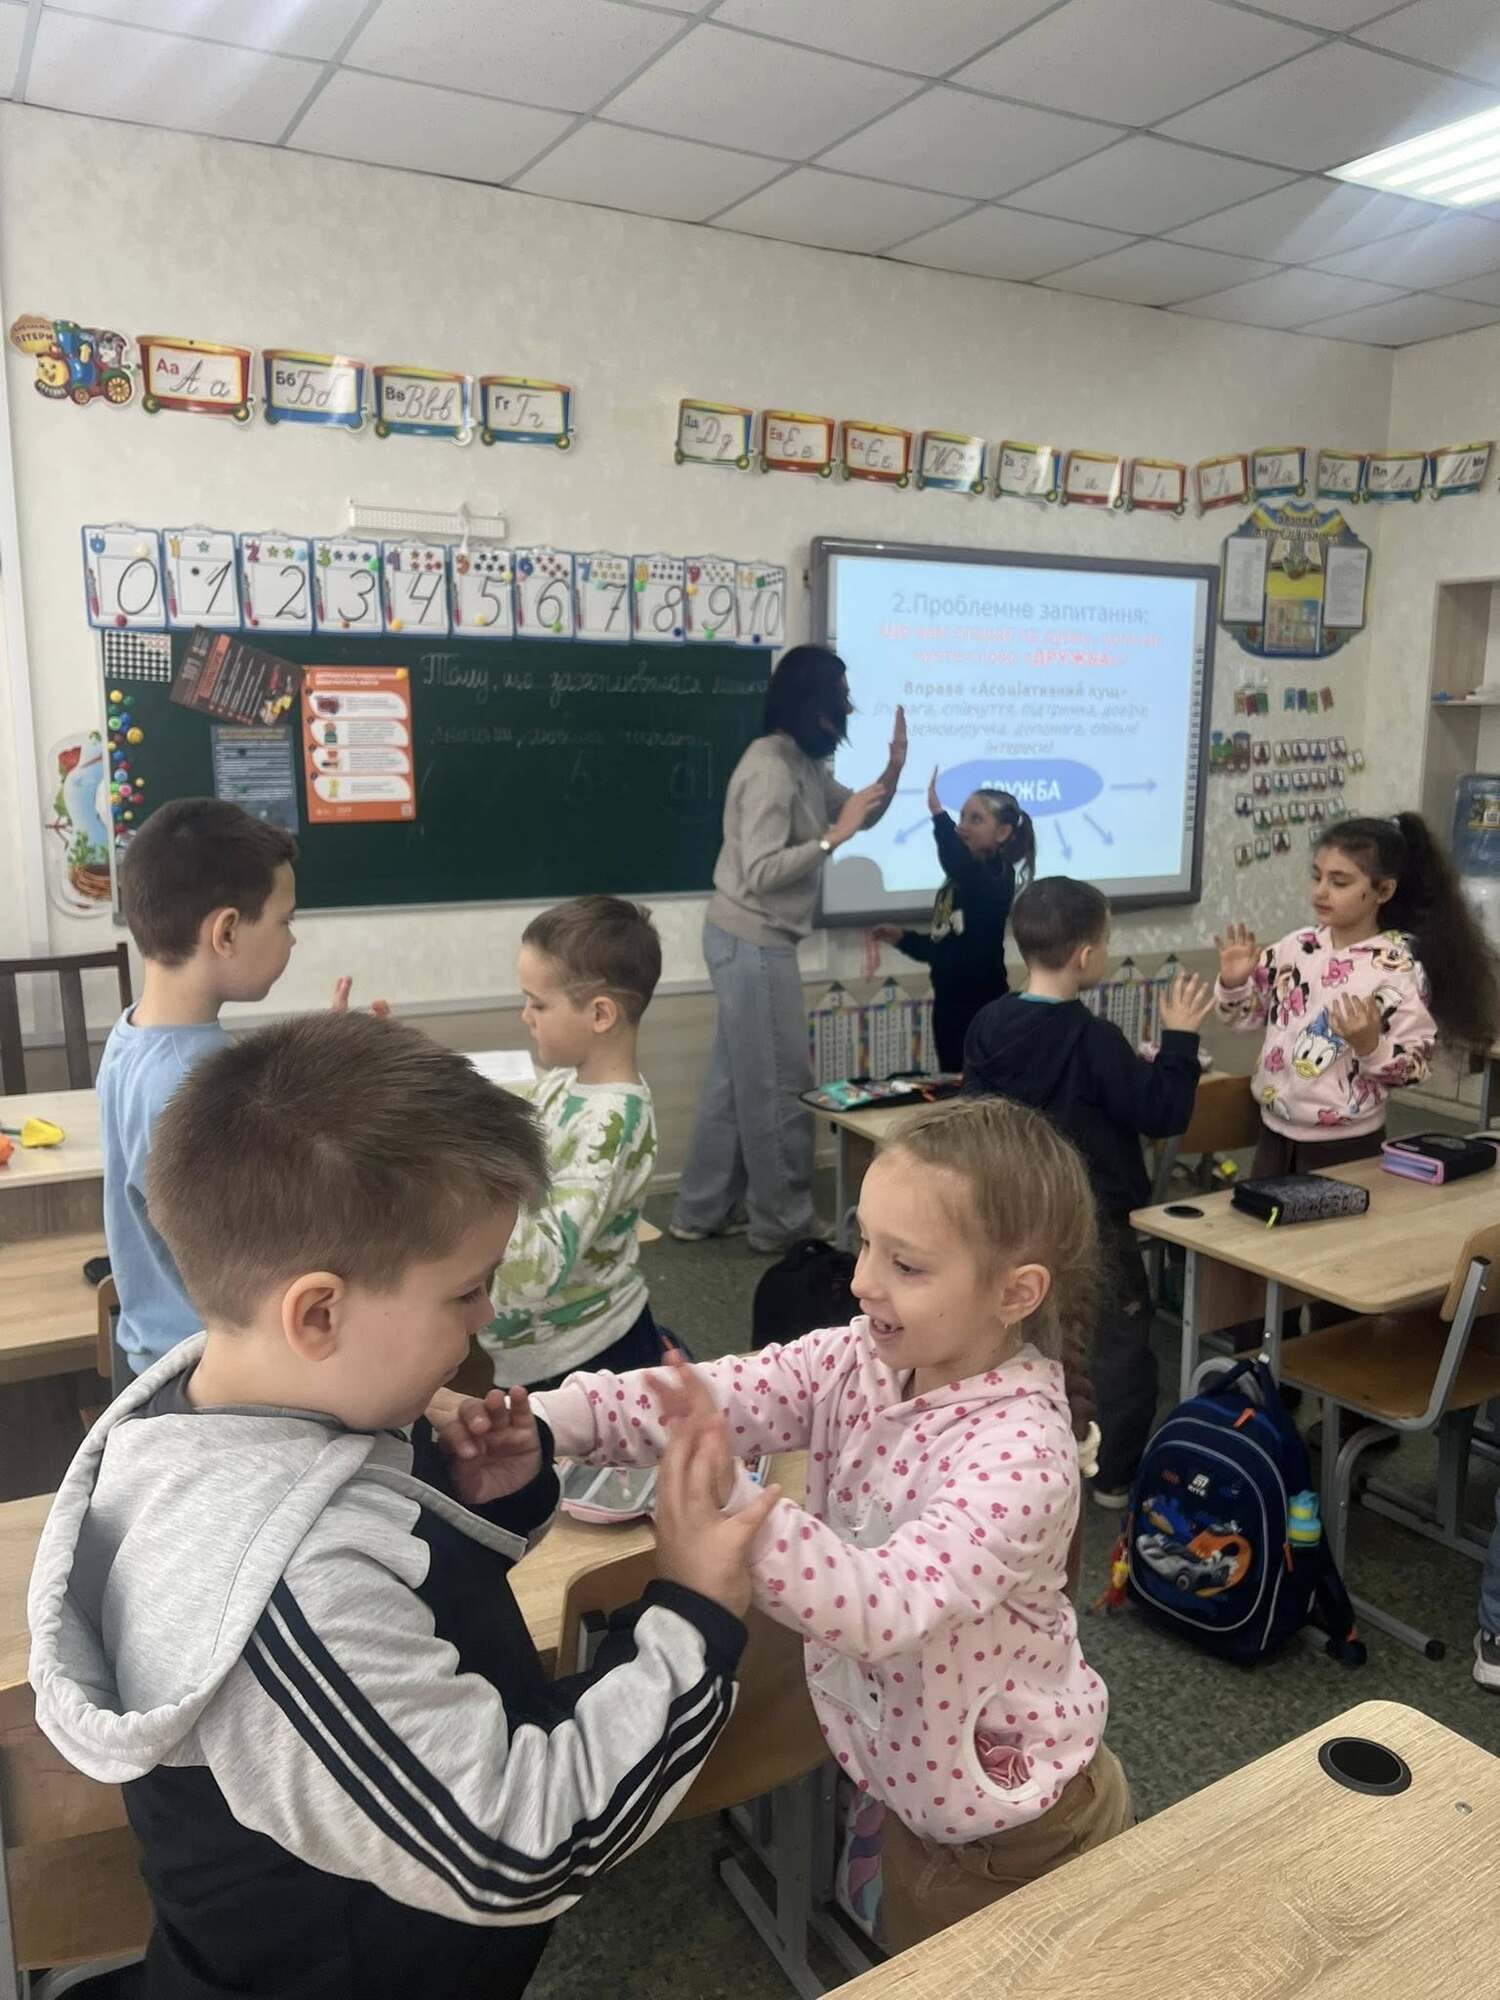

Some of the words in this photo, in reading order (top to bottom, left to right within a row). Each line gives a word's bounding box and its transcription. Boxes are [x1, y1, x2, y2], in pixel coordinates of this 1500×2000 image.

[155, 357, 180, 375] Аа
[275, 371, 297, 387] Бб
[117, 557, 158, 615] 0
[206, 560, 232, 614] 1
[275, 565, 307, 619] 2
[337, 568, 376, 622] 3
[409, 573, 443, 624] 4
[481, 575, 508, 626] 5
[536, 579, 570, 628] 6
[601, 582, 627, 632] 7
[652, 584, 686, 633] 8
[700, 584, 732, 632] 9
